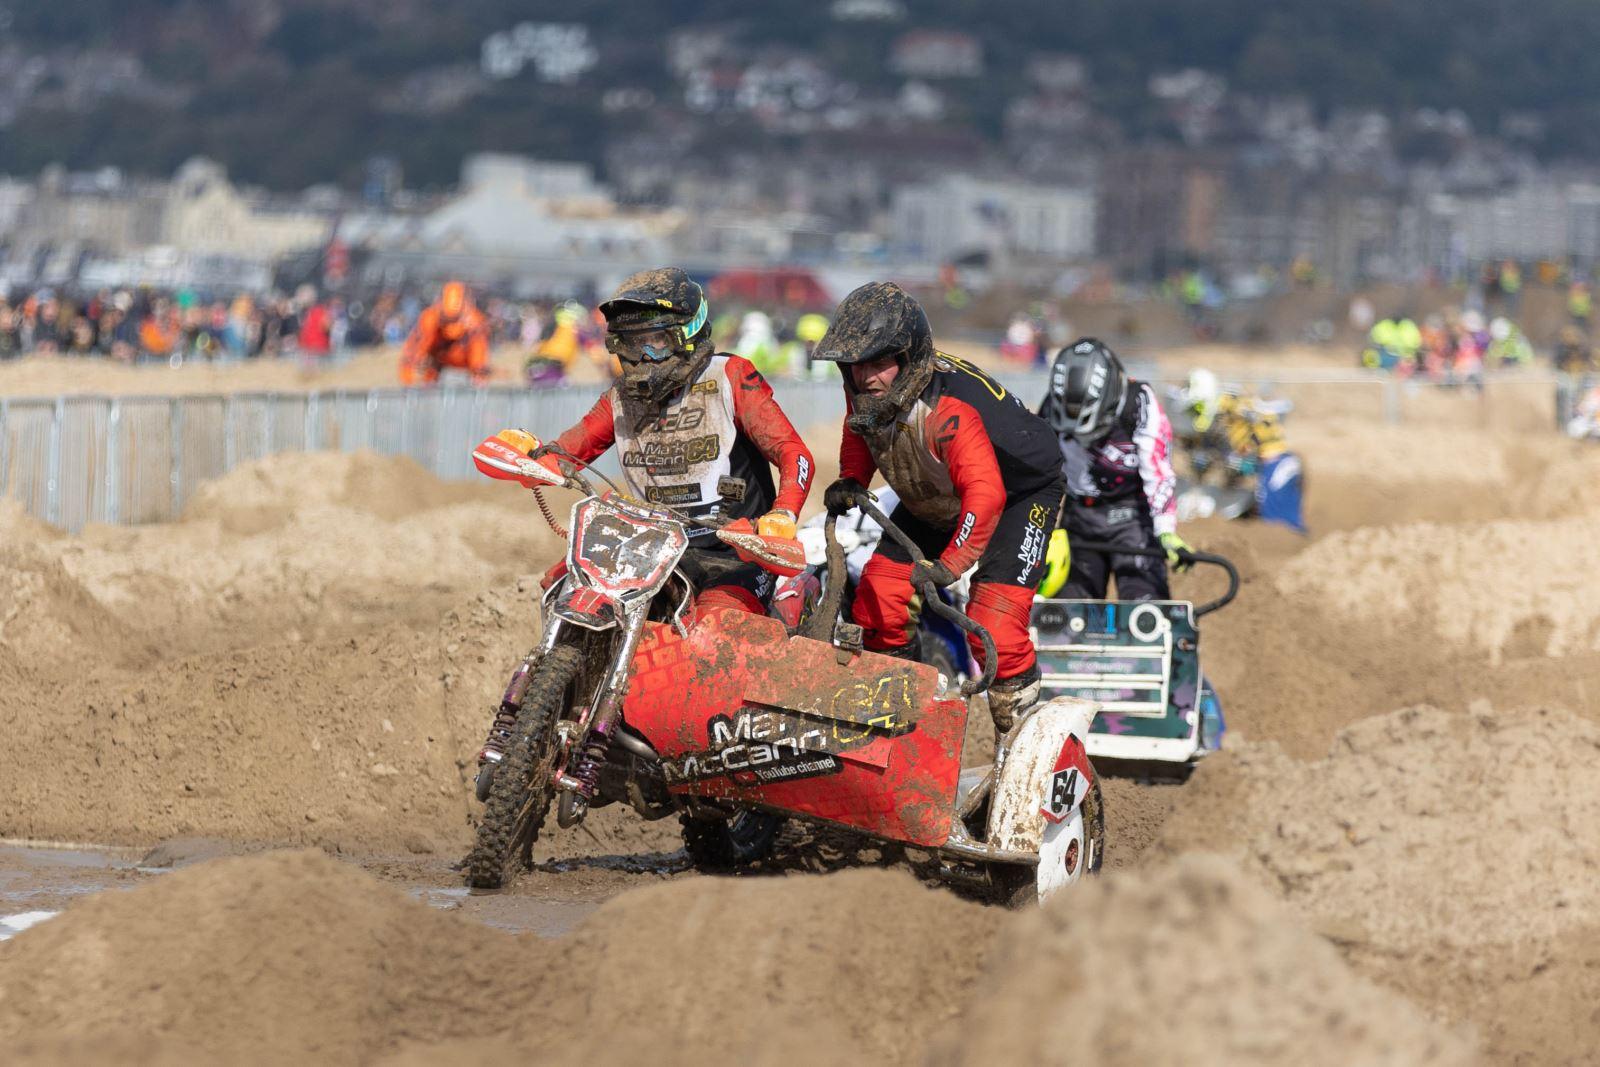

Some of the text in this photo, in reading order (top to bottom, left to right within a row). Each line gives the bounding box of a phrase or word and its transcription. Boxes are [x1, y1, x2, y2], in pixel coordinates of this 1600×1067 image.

[624, 451, 685, 466] McCann
[645, 436, 719, 463] Mark 64
[1017, 522, 1036, 563] Mark
[1017, 528, 1043, 585] McCann
[663, 729, 826, 782] McCann
[755, 755, 836, 781] YouTube channel
[1051, 769, 1078, 814] 64
